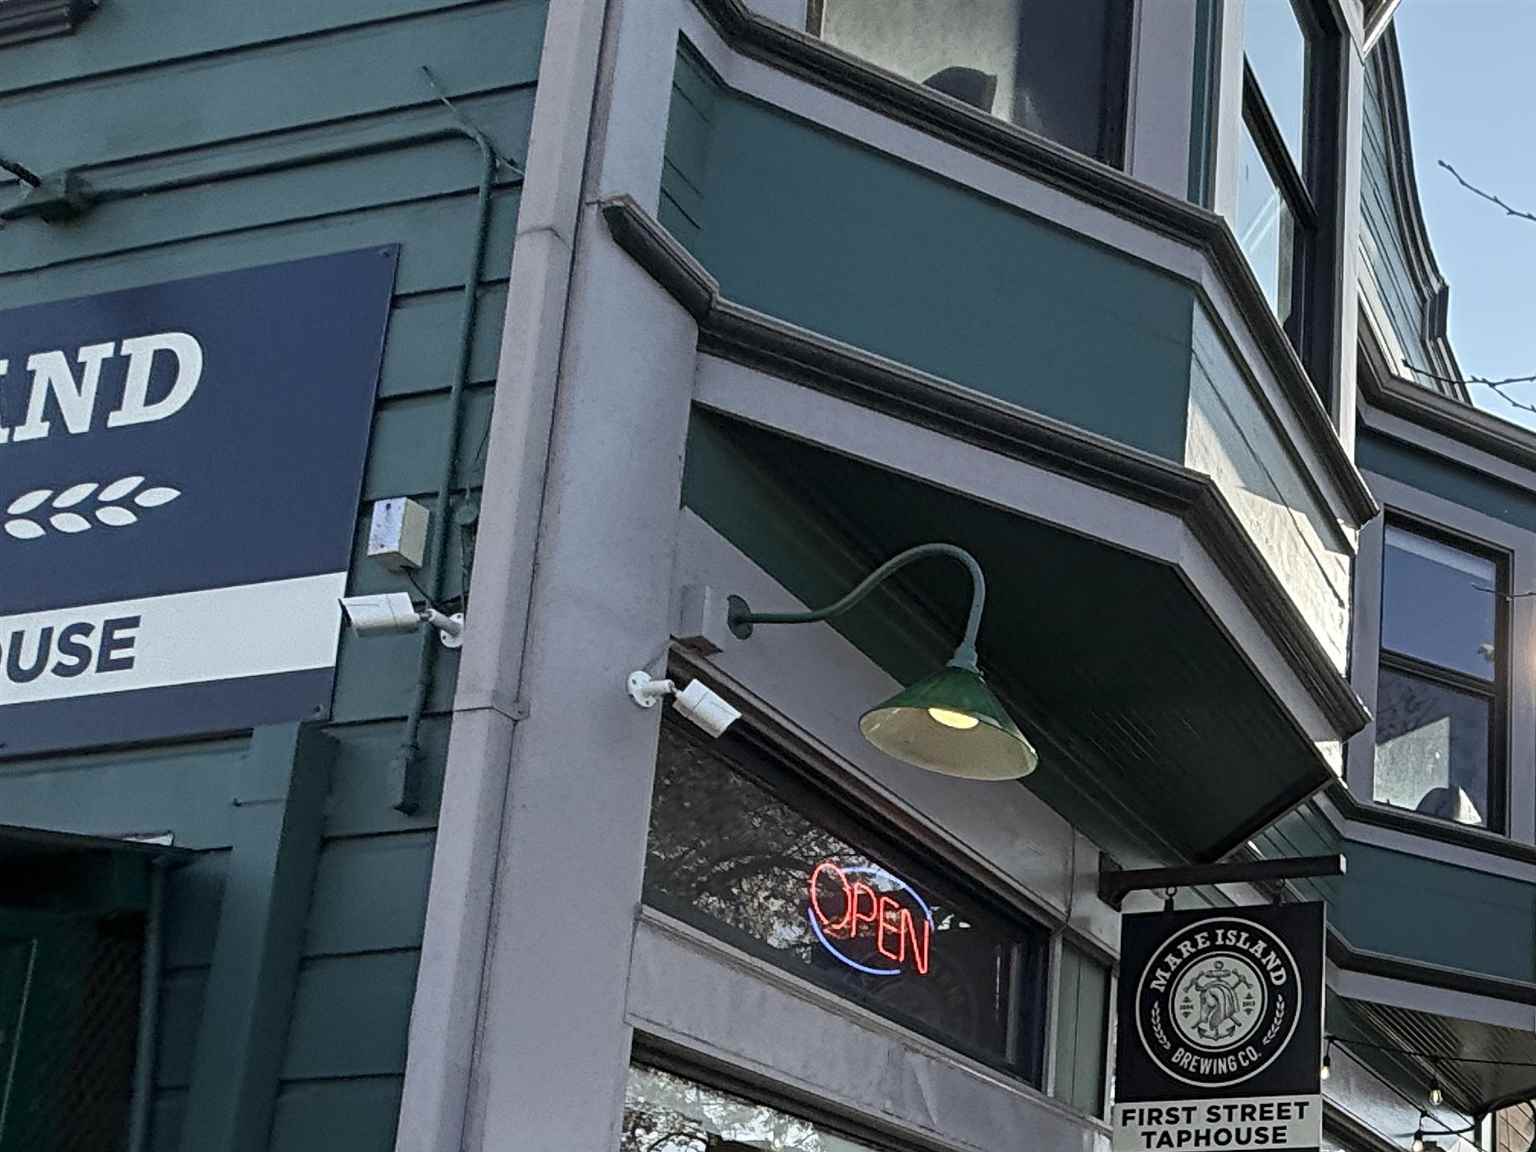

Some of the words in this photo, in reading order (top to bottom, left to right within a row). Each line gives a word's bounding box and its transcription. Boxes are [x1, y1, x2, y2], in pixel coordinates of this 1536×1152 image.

[0, 331, 203, 444] ND
[0, 615, 142, 684] USE
[811, 861, 930, 974] OPEN
[1150, 931, 1211, 993] MARE
[1215, 929, 1287, 986] ISLAND
[1171, 1047, 1238, 1075] BREWING
[1238, 1045, 1262, 1067] CO.
[1121, 1105, 1198, 1127] FIRST
[1205, 1101, 1310, 1124] STREET
[1141, 1125, 1288, 1149] TAPHOUSE
